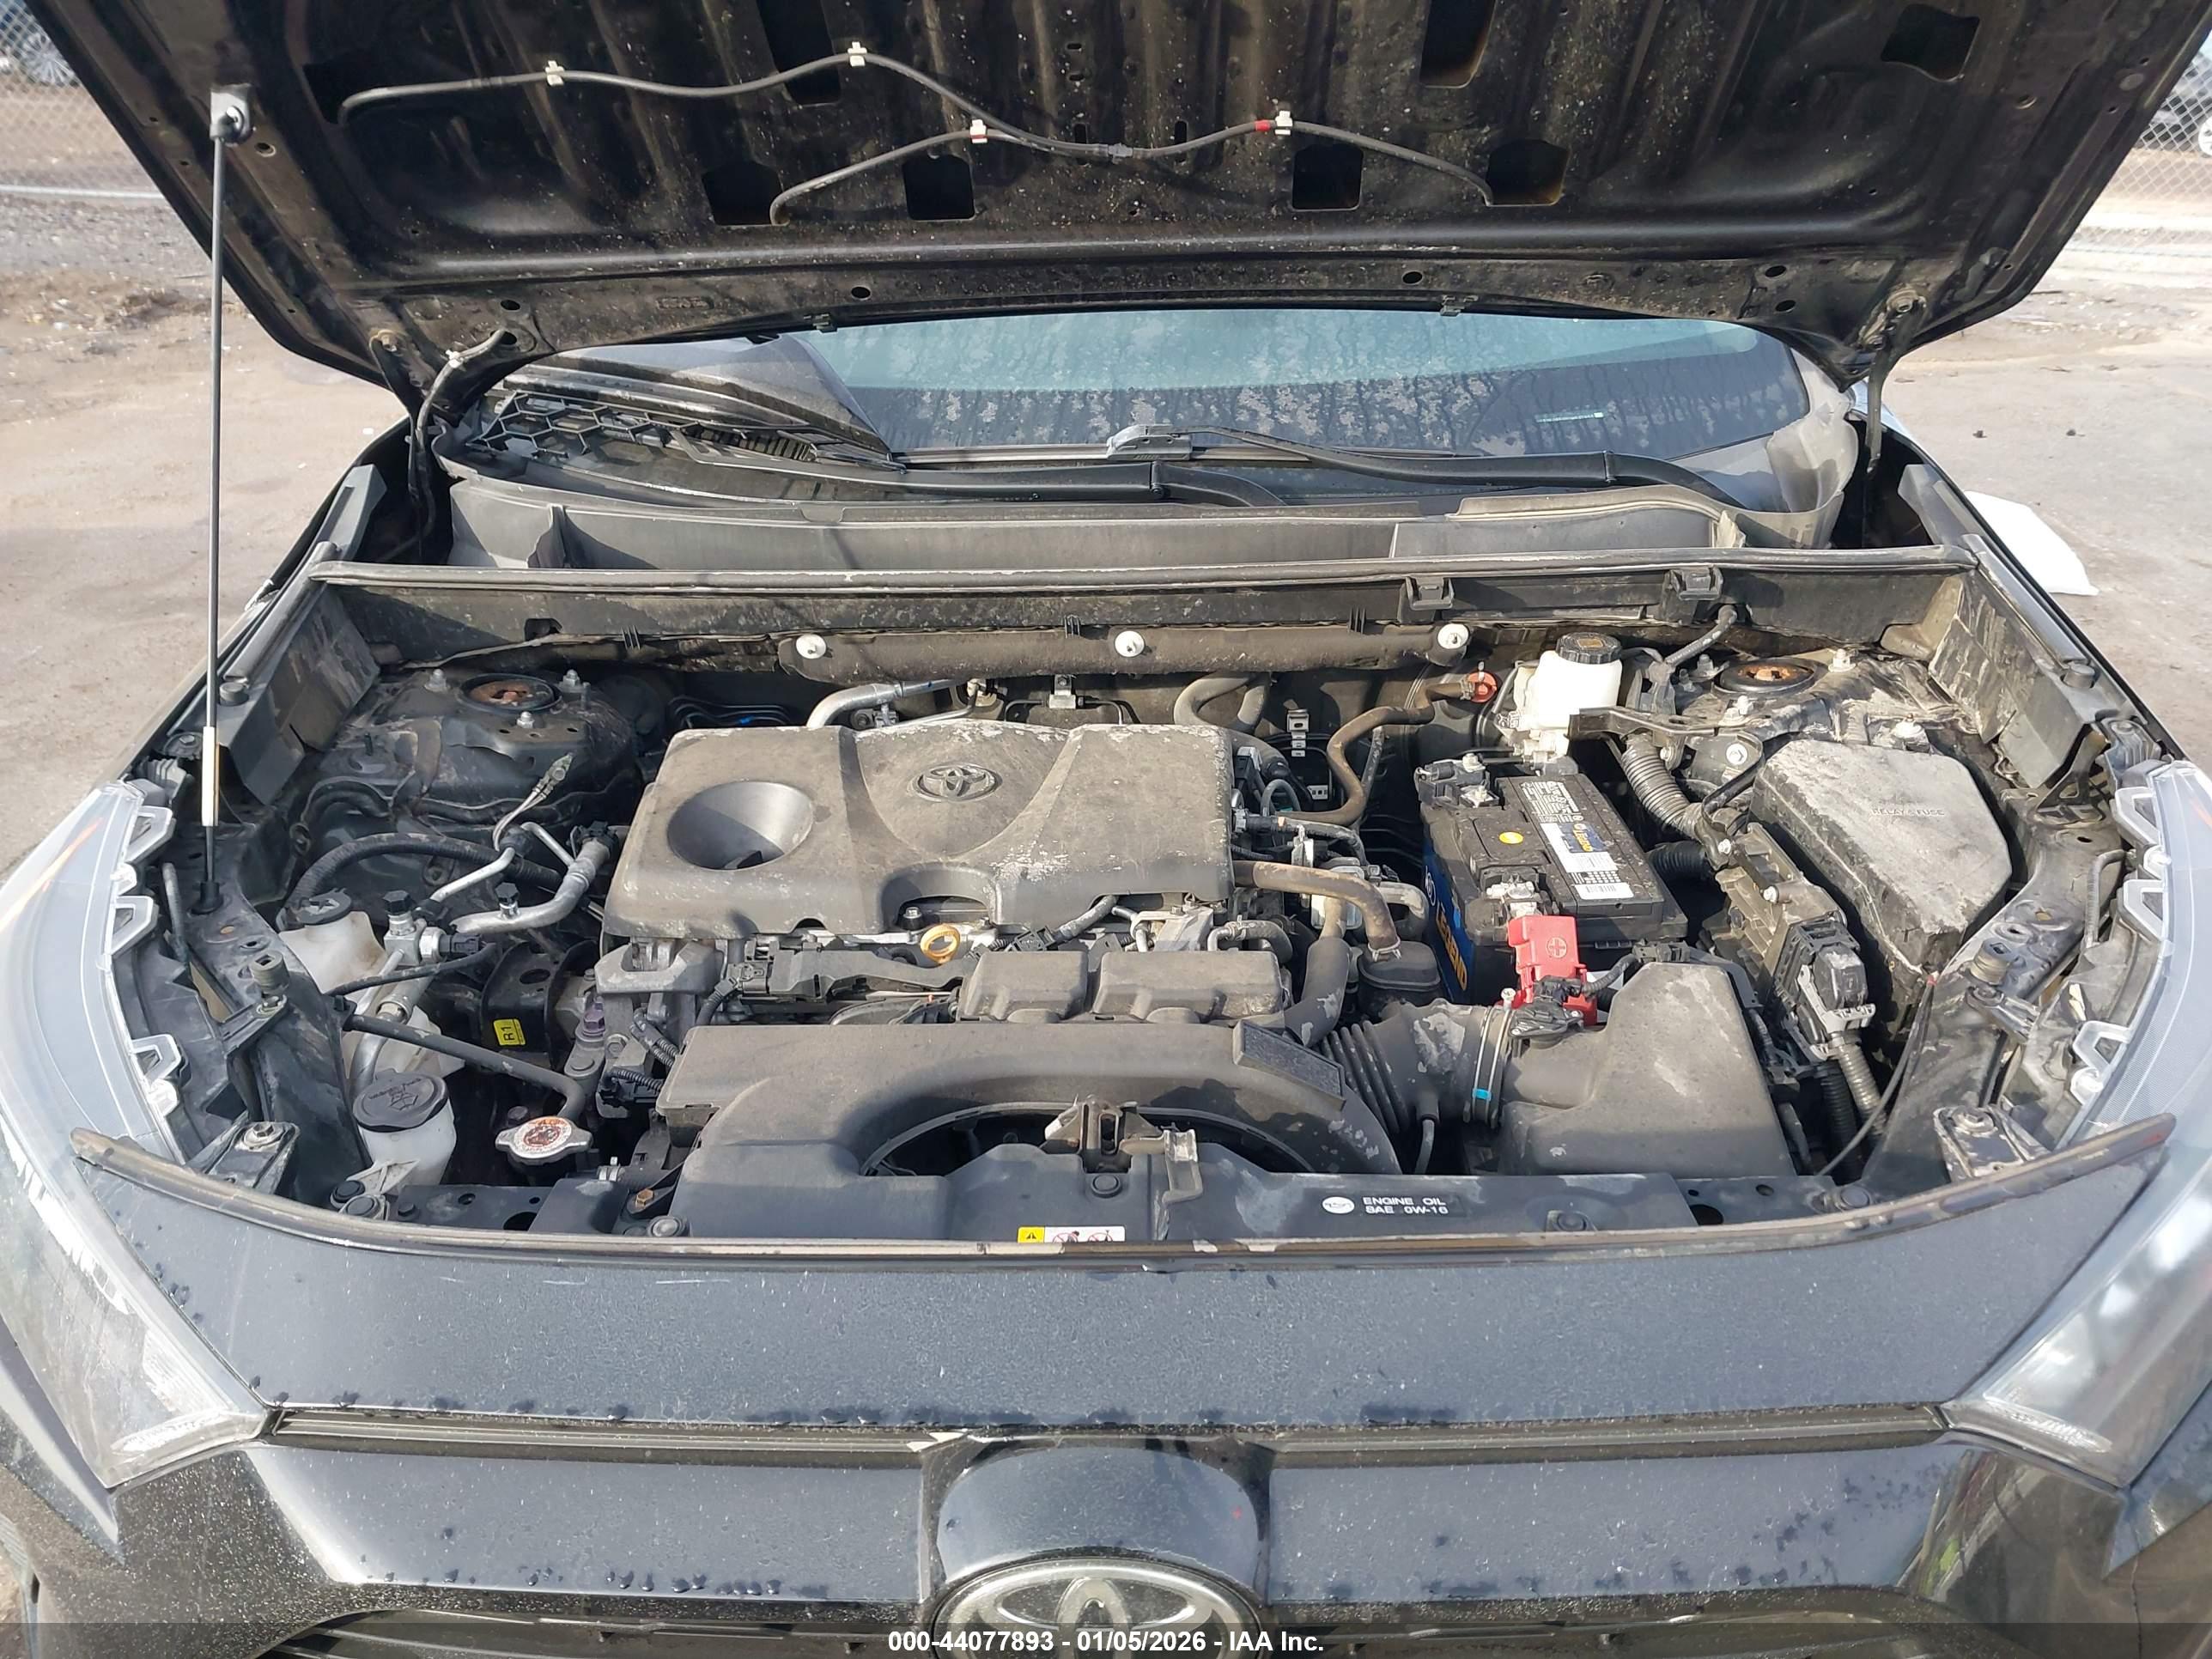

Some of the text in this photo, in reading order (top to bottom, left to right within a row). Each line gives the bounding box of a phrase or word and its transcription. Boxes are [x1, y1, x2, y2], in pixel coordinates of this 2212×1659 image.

[1572, 830, 1594, 852] LEGEND
[1436, 900, 1468, 991] LEGEND
[501, 1026, 515, 1041] R1
[1362, 1196, 1447, 1206] ENGINE OIL
[1364, 1206, 1449, 1215] SAE 0W-16
